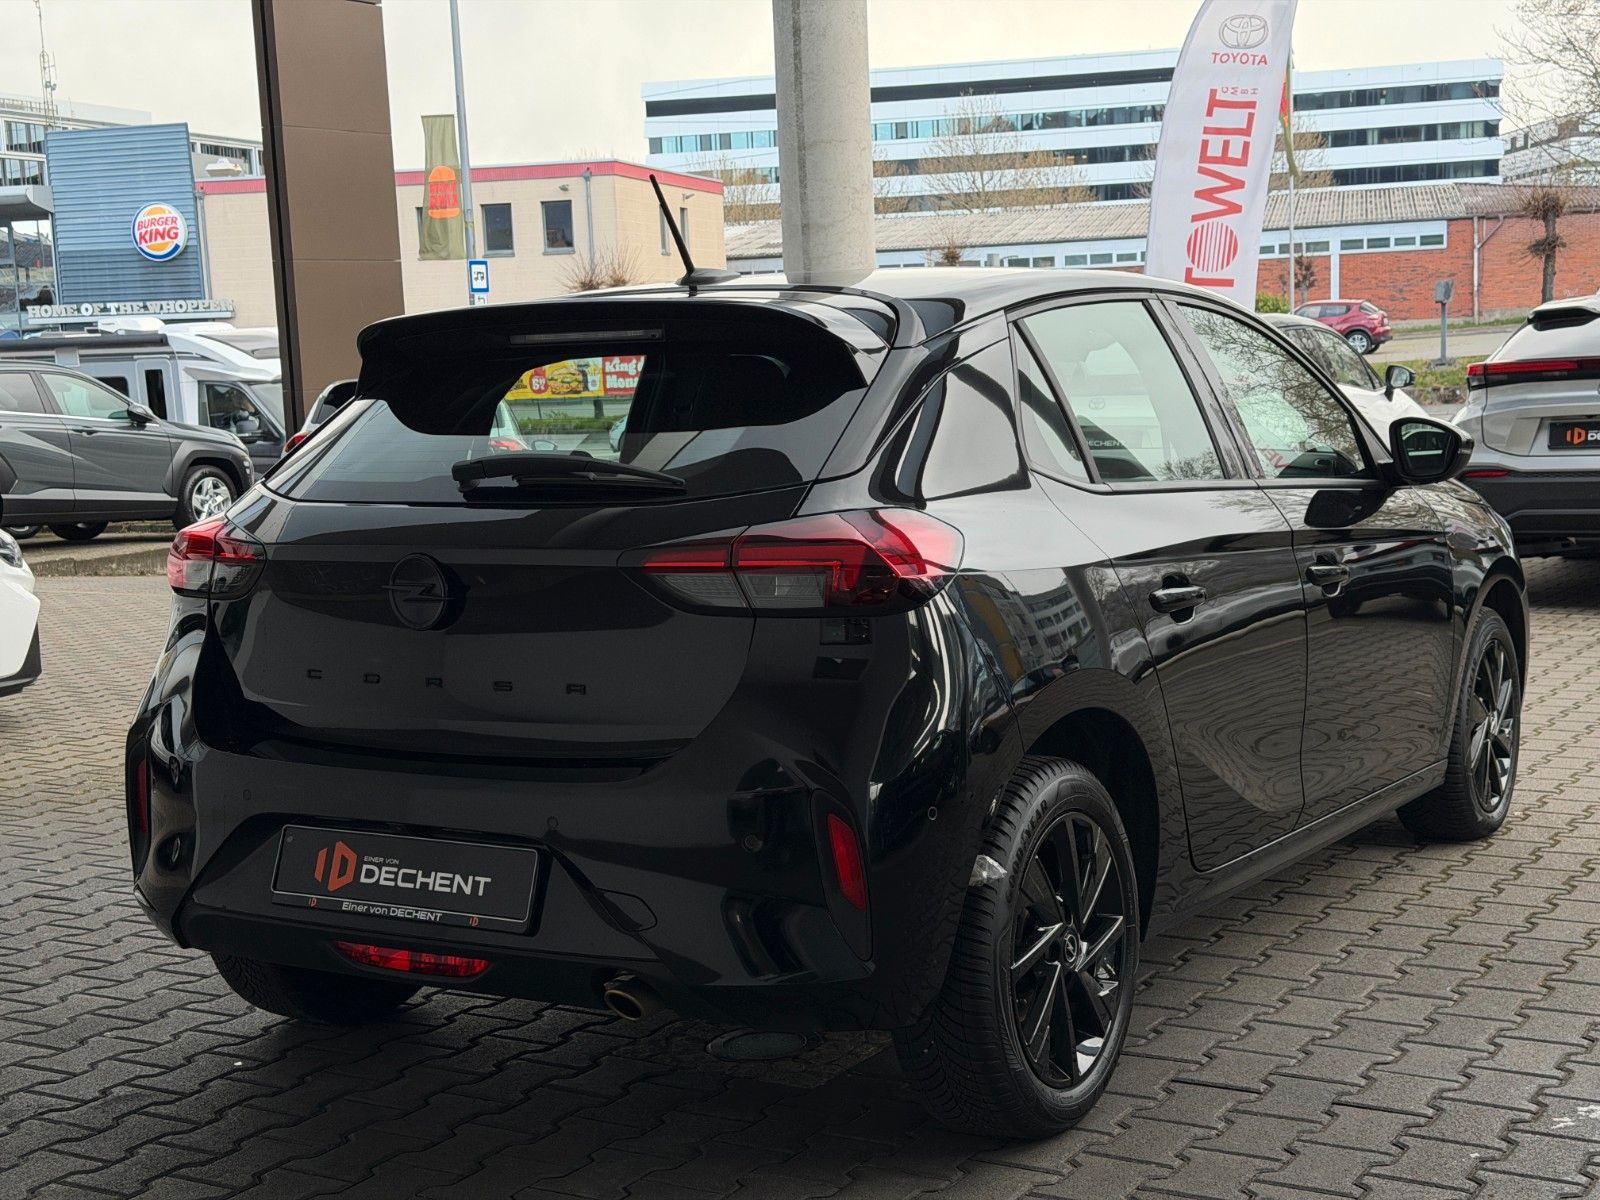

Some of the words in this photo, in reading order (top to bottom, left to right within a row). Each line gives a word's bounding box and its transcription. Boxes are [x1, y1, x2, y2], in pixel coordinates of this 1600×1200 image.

[1211, 52, 1268, 66] TOYOTA
[137, 216, 179, 231] BURGER
[138, 226, 180, 246] KING
[27, 304, 77, 318] HOME
[80, 303, 101, 316] OF
[107, 302, 145, 315] THE
[147, 299, 234, 314] WHOPPER
[605, 358, 637, 375] King
[306, 669, 586, 695] CORSA
[364, 855, 384, 863] EINER
[386, 857, 400, 865] VON
[360, 864, 492, 897] DECHENT
[342, 902, 368, 914] Einer
[370, 906, 389, 915] von
[390, 907, 442, 922] DECHENT
